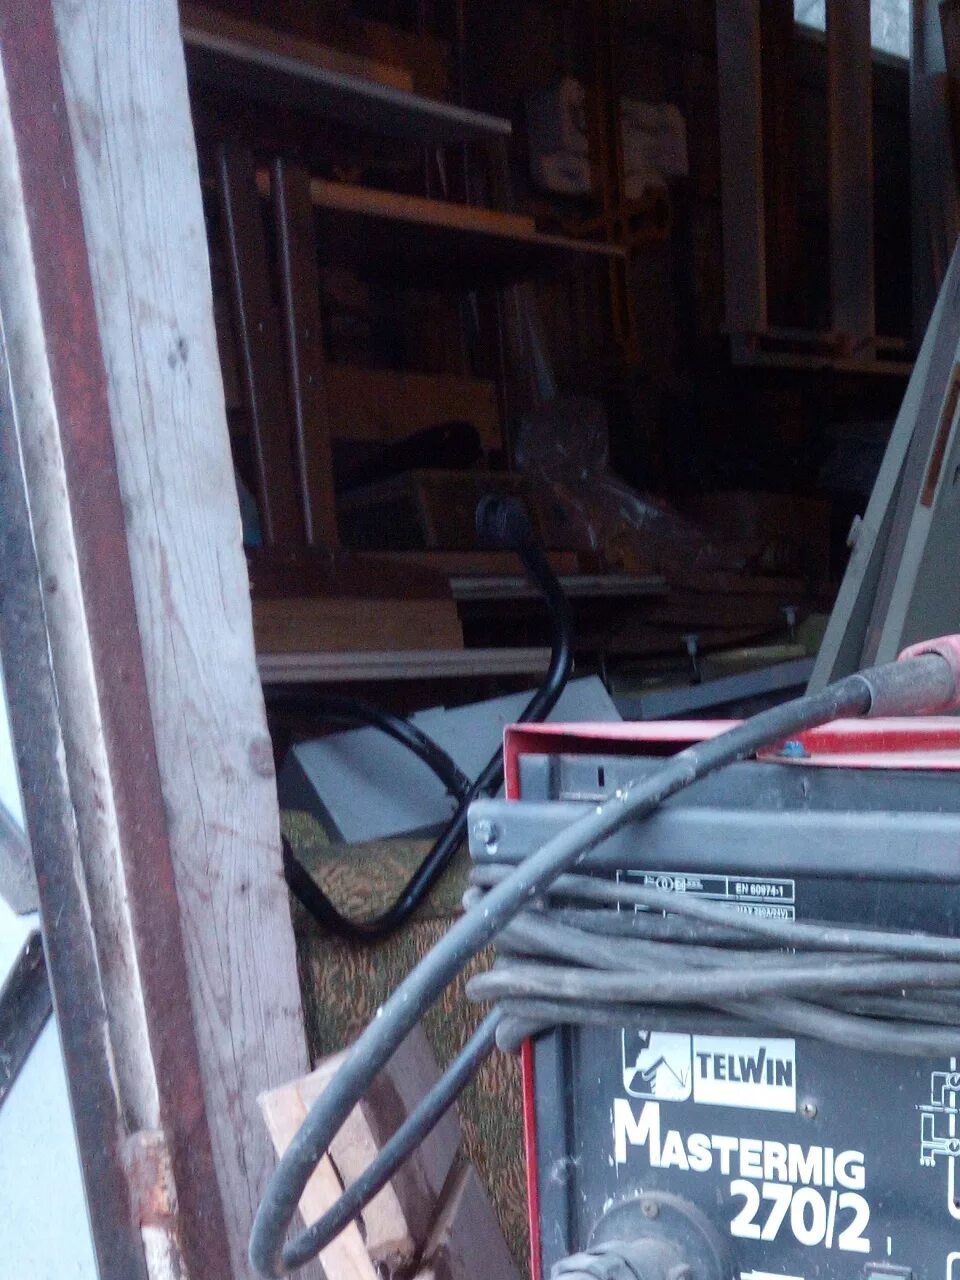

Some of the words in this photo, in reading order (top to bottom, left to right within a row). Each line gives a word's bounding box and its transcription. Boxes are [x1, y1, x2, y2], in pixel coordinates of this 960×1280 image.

[735, 882, 749, 895] EN
[696, 1047, 793, 1088] TELWIN
[613, 1098, 866, 1191] MASTERMIG
[729, 1179, 871, 1254] 270/2
